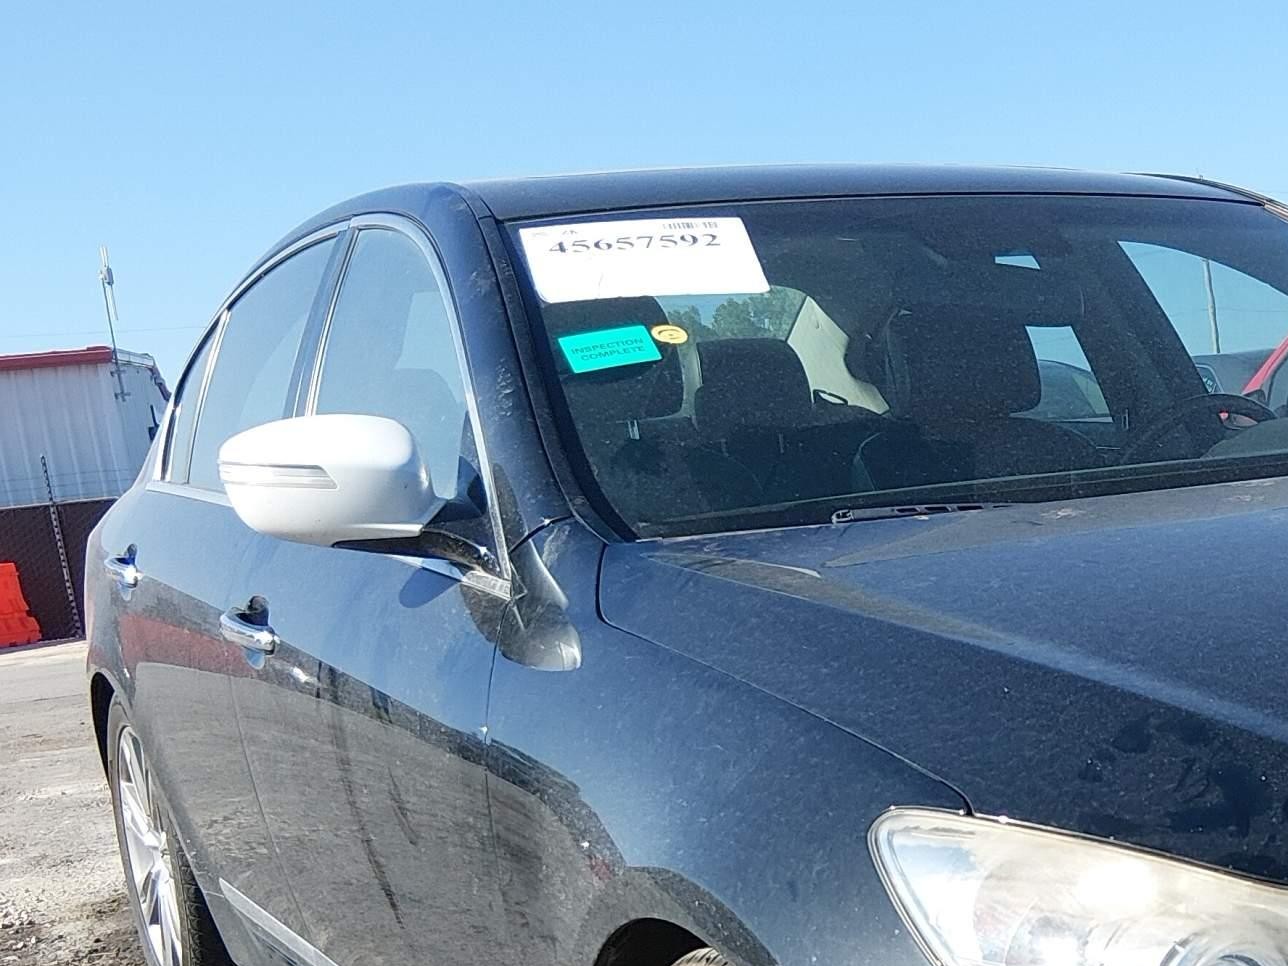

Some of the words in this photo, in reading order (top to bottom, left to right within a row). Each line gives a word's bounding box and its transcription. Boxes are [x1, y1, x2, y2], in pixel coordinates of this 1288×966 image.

[549, 233, 721, 254] 45657592
[570, 337, 645, 355] INSPECTION
[581, 345, 646, 361] COMPLETE
